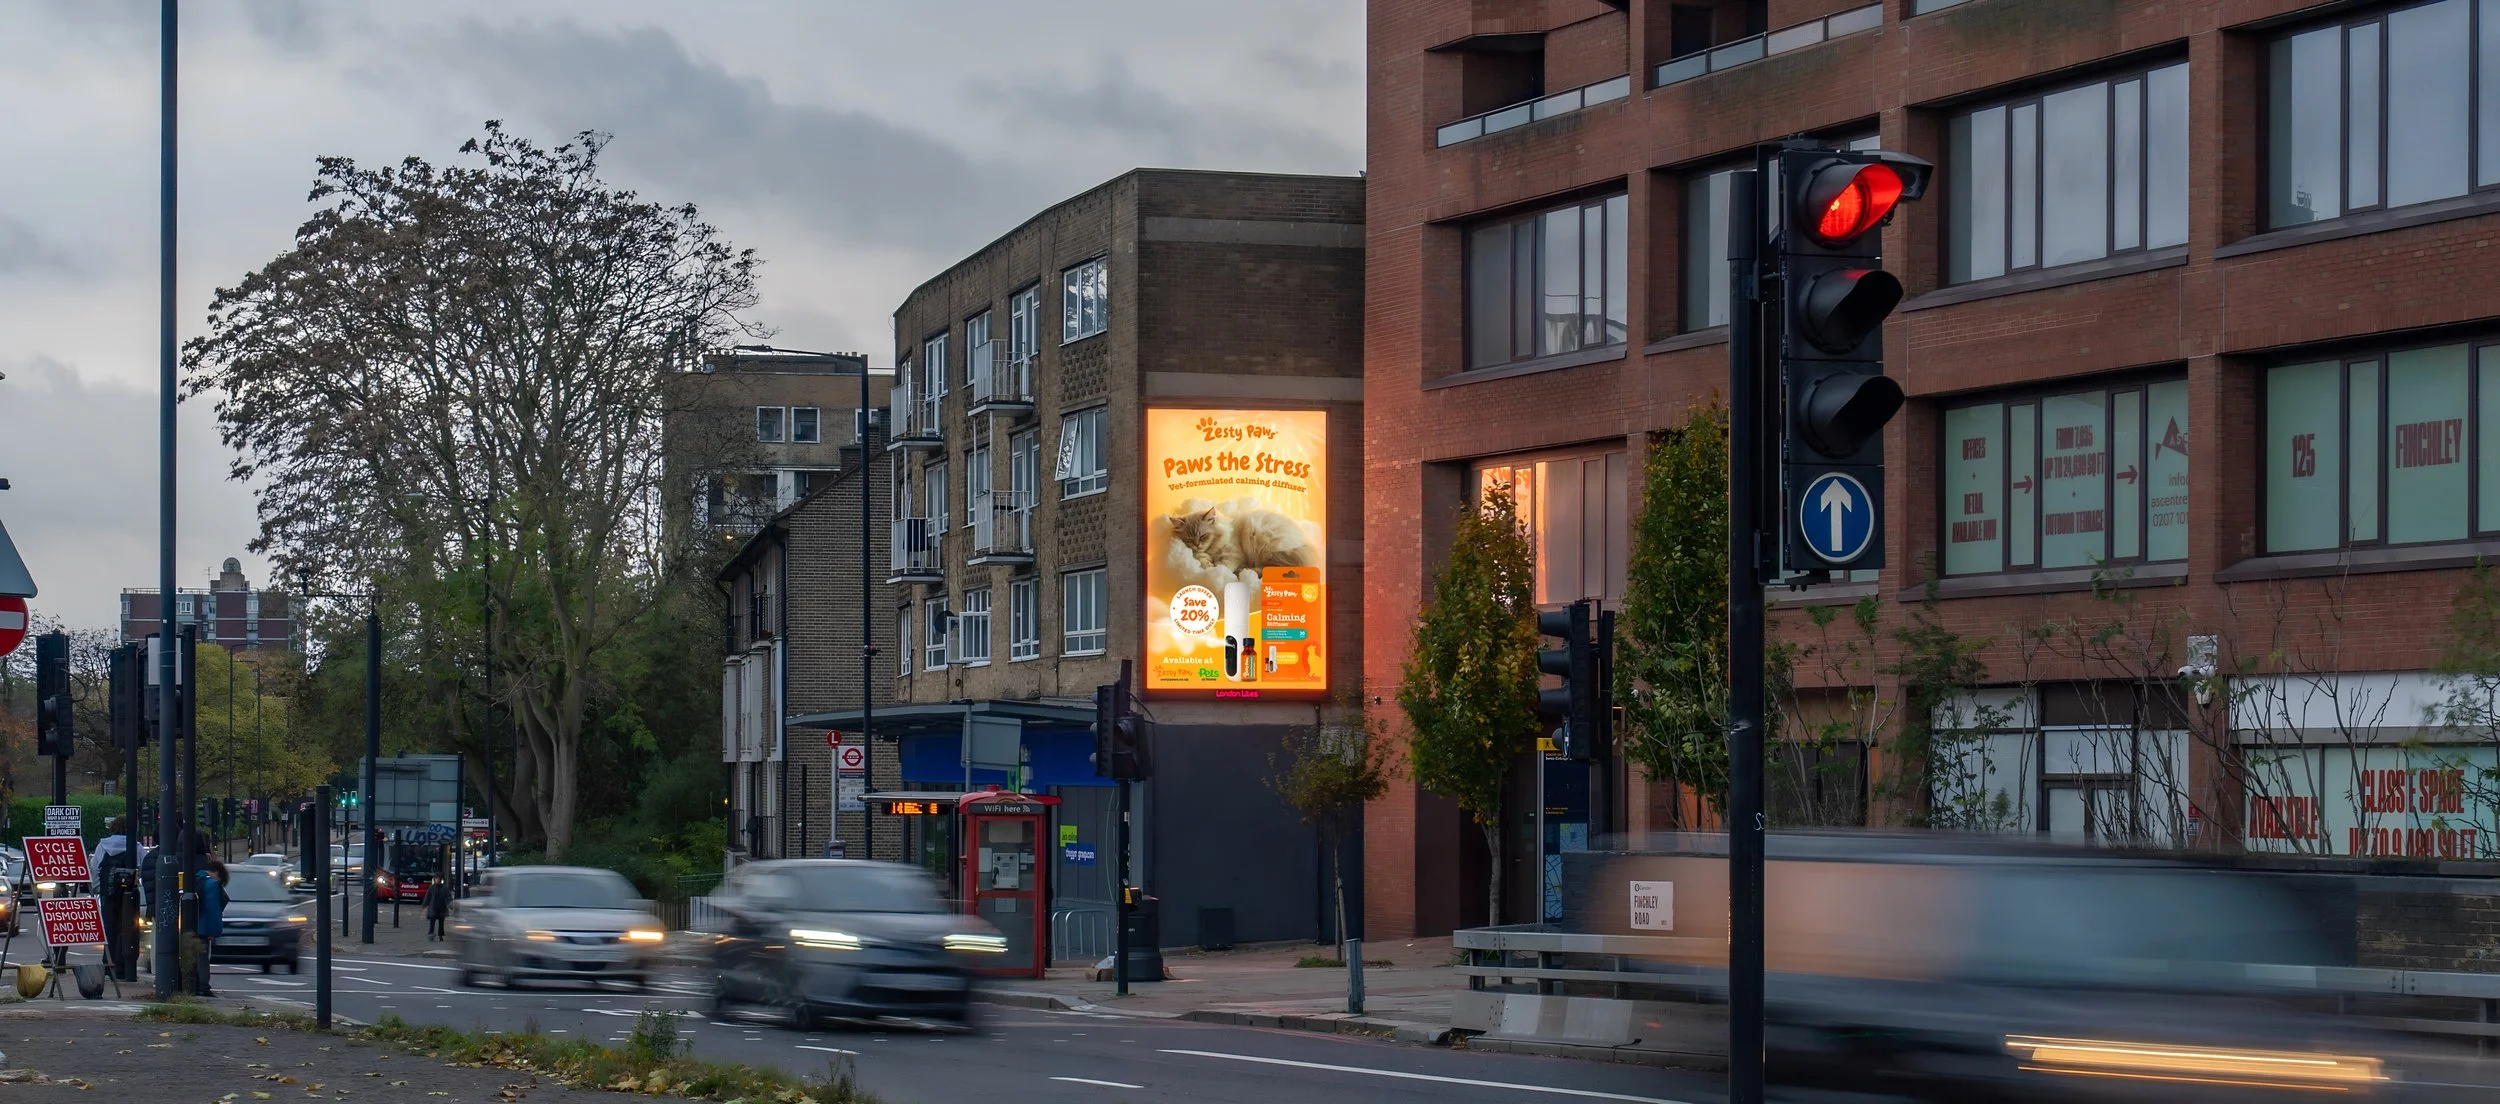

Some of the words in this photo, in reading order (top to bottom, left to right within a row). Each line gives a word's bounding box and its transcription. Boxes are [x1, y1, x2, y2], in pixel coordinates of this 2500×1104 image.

[1202, 426, 1242, 441] Zesty
[1246, 424, 1276, 440] Paws
[1962, 437, 1986, 461] OFFICES
[2292, 433, 2315, 478] 125
[2395, 418, 2462, 469] FINCHLEY
[1163, 455, 1212, 479] Paws
[1217, 451, 1250, 472] the
[1255, 452, 1311, 479] Stress
[2044, 456, 2054, 480] UP
[2054, 456, 2063, 479] TO
[2097, 451, 2105, 475] FT
[1168, 477, 1234, 491] Vet-formulated
[1235, 477, 1271, 488] calming
[1272, 480, 1307, 493] diffuser
[2168, 472, 2188, 487] info
[1964, 493, 1984, 515] RETAIL
[1952, 520, 1983, 543] AVAILABLE
[1983, 519, 1997, 541] NOW
[1183, 597, 1207, 607] Save
[1180, 609, 1210, 622] 20%
[1266, 613, 1306, 624] Calming
[1198, 667, 1219, 678] Pets
[1216, 690, 1241, 698] London
[831, 732, 839, 744] L
[2361, 769, 2405, 813] CLASS
[2419, 769, 2465, 814] SPACE
[47, 808, 64, 816] DARK
[65, 808, 80, 816] CITY
[1003, 804, 1021, 813] here
[34, 841, 77, 853] CYCLE
[40, 854, 76, 865] LANE
[34, 866, 87, 877] CLOSED
[45, 900, 94, 911] CYCLISTS
[1634, 895, 1658, 909] FINCHLEY
[45, 910, 98, 922] DISMOUNT
[1634, 912, 1650, 925] ROAD
[53, 922, 74, 932] AND
[76, 921, 97, 931] USE
[52, 932, 99, 943] FOOTWAY
